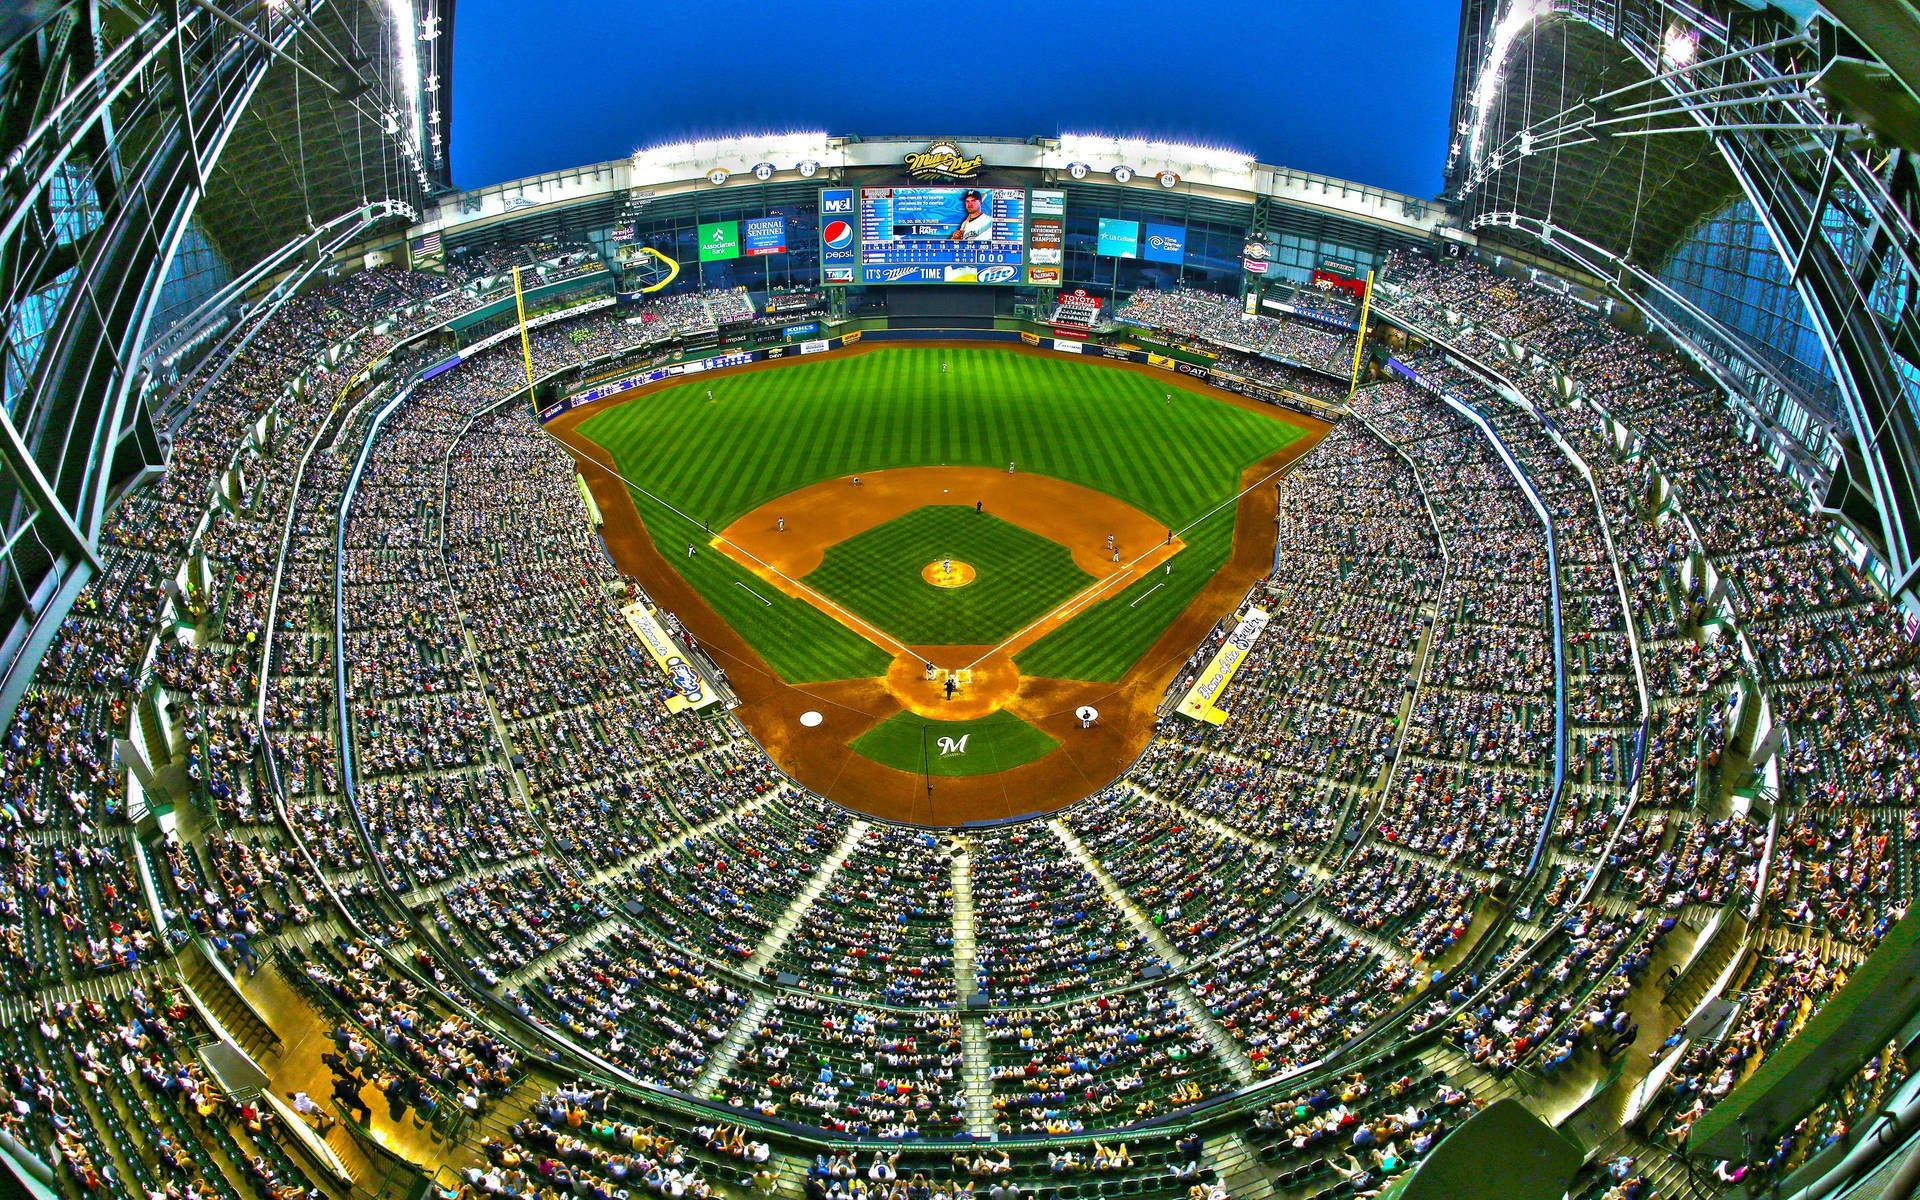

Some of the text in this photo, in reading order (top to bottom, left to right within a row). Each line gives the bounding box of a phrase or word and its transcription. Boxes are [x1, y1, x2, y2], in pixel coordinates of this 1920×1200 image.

[904, 153, 982, 174] Miller Park
[712, 173, 725, 182] 42
[758, 168, 769, 177] 44
[748, 221, 784, 231] JOURNAL
[911, 226, 917, 235] 1
[747, 227, 784, 237] SENTINEL
[702, 240, 736, 250] Associated
[711, 247, 726, 255] Bank
[980, 254, 1004, 262] 0 0 0
[866, 269, 881, 280] IT'S
[882, 266, 920, 282] Miller
[1063, 294, 1096, 304] TOYOTA
[787, 325, 814, 333] KOHL'S
[725, 335, 747, 343] impact
[1190, 367, 1207, 377] ATI
[1197, 616, 1268, 701] Home of the Brewers
[937, 733, 971, 756] M
